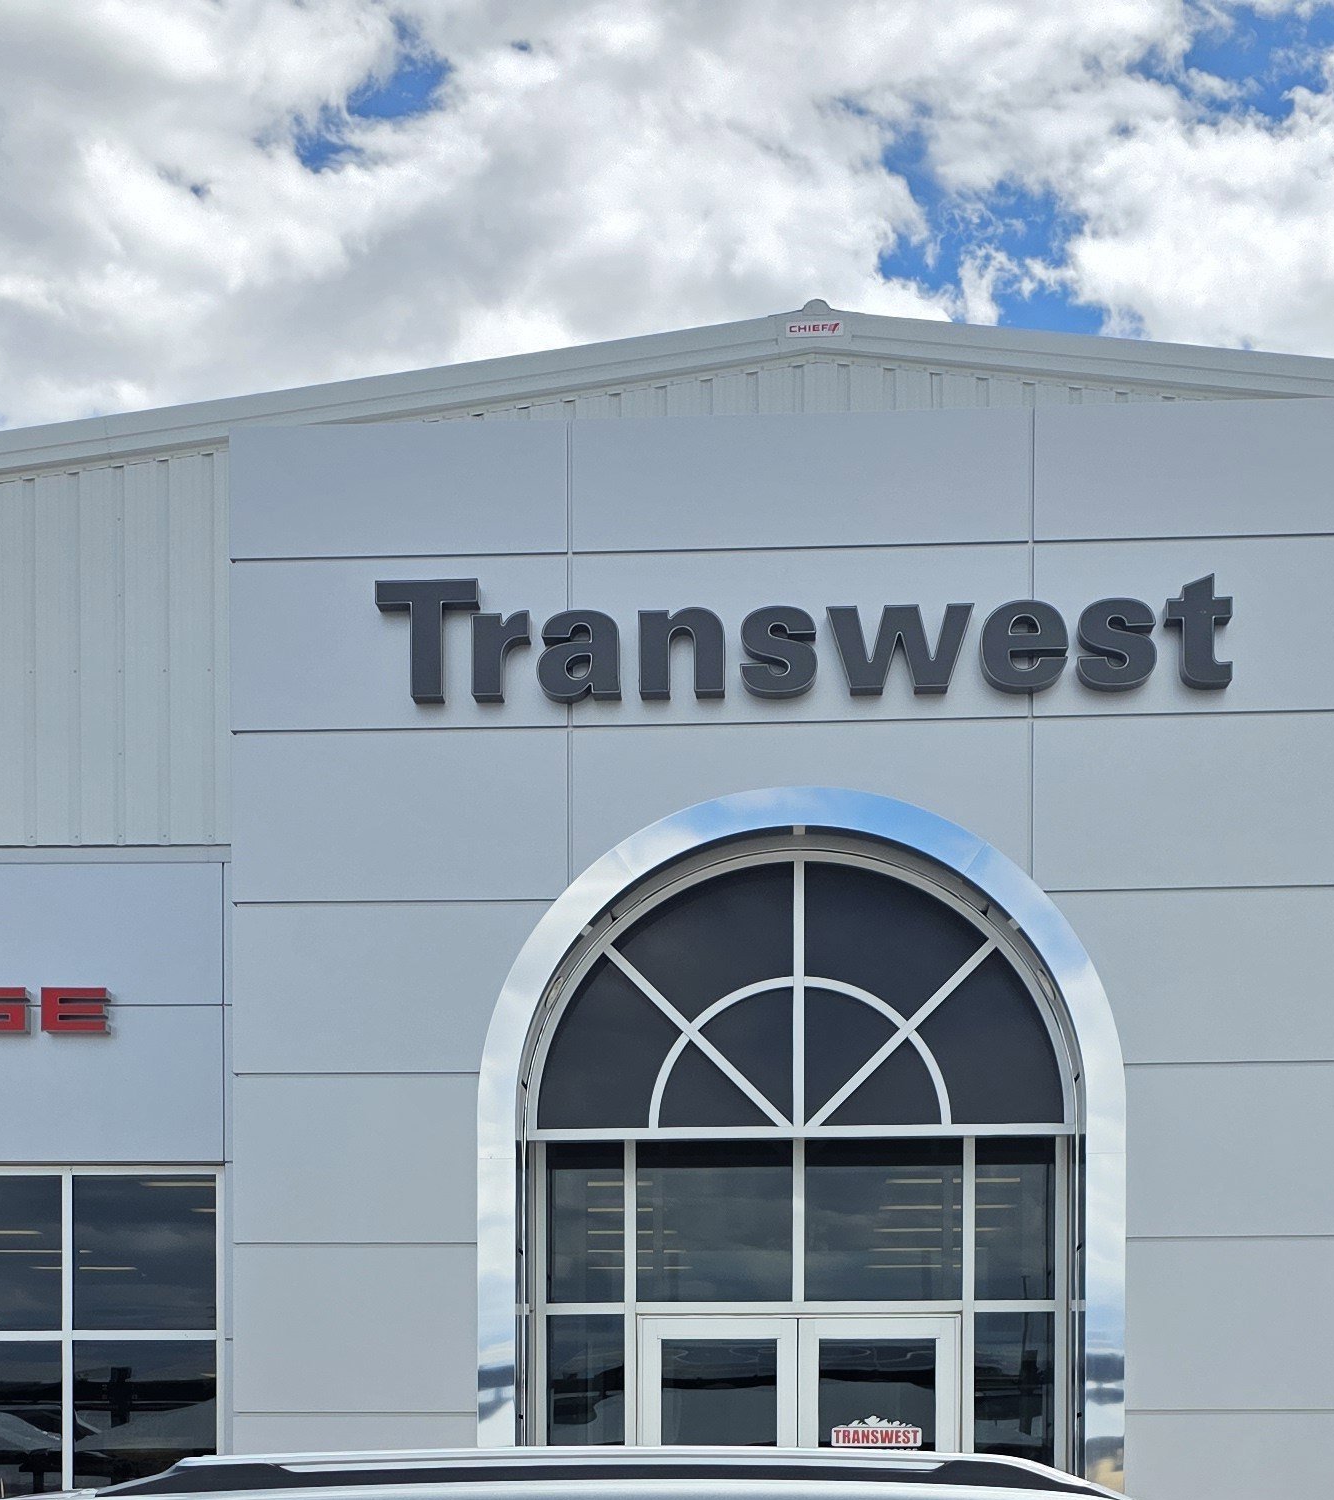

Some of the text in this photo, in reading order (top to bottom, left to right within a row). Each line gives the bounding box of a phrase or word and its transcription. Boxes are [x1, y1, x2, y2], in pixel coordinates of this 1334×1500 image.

[789, 324, 828, 333] CHIEF
[374, 572, 1233, 705] Transwest
[833, 1429, 919, 1444] TRANSWEST
